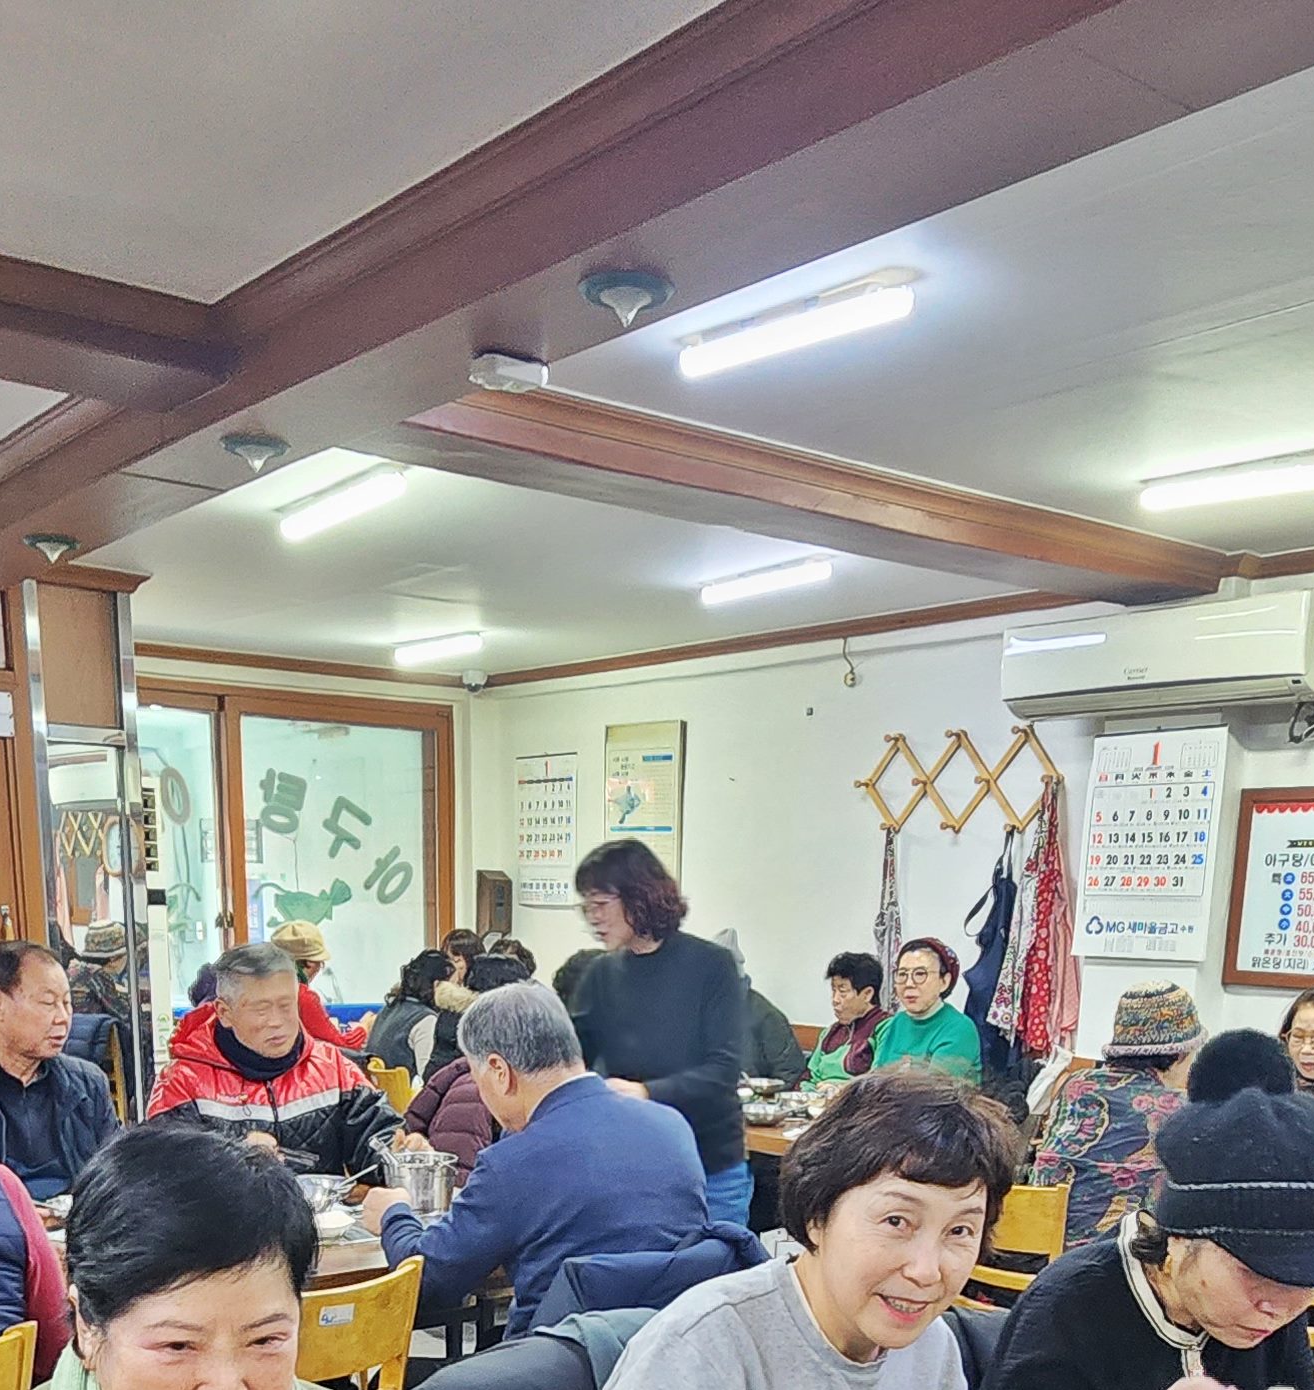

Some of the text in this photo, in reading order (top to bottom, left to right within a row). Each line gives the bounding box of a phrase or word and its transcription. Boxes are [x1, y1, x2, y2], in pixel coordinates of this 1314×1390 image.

[1152, 741, 1161, 766] 1
[1149, 786, 1208, 798] 1 2 3 4
[1095, 808, 1208, 822] 5 6 7 8 9 10 11
[1092, 832, 1205, 844] 12 13 14 15 16 17 18
[1090, 854, 1203, 865] 19 20 21 22 23 24 25
[1087, 876, 1184, 886] 26 27 28 29 30 31
[1106, 921, 1125, 933] MG
[1128, 922, 1178, 934] 새마을금고
